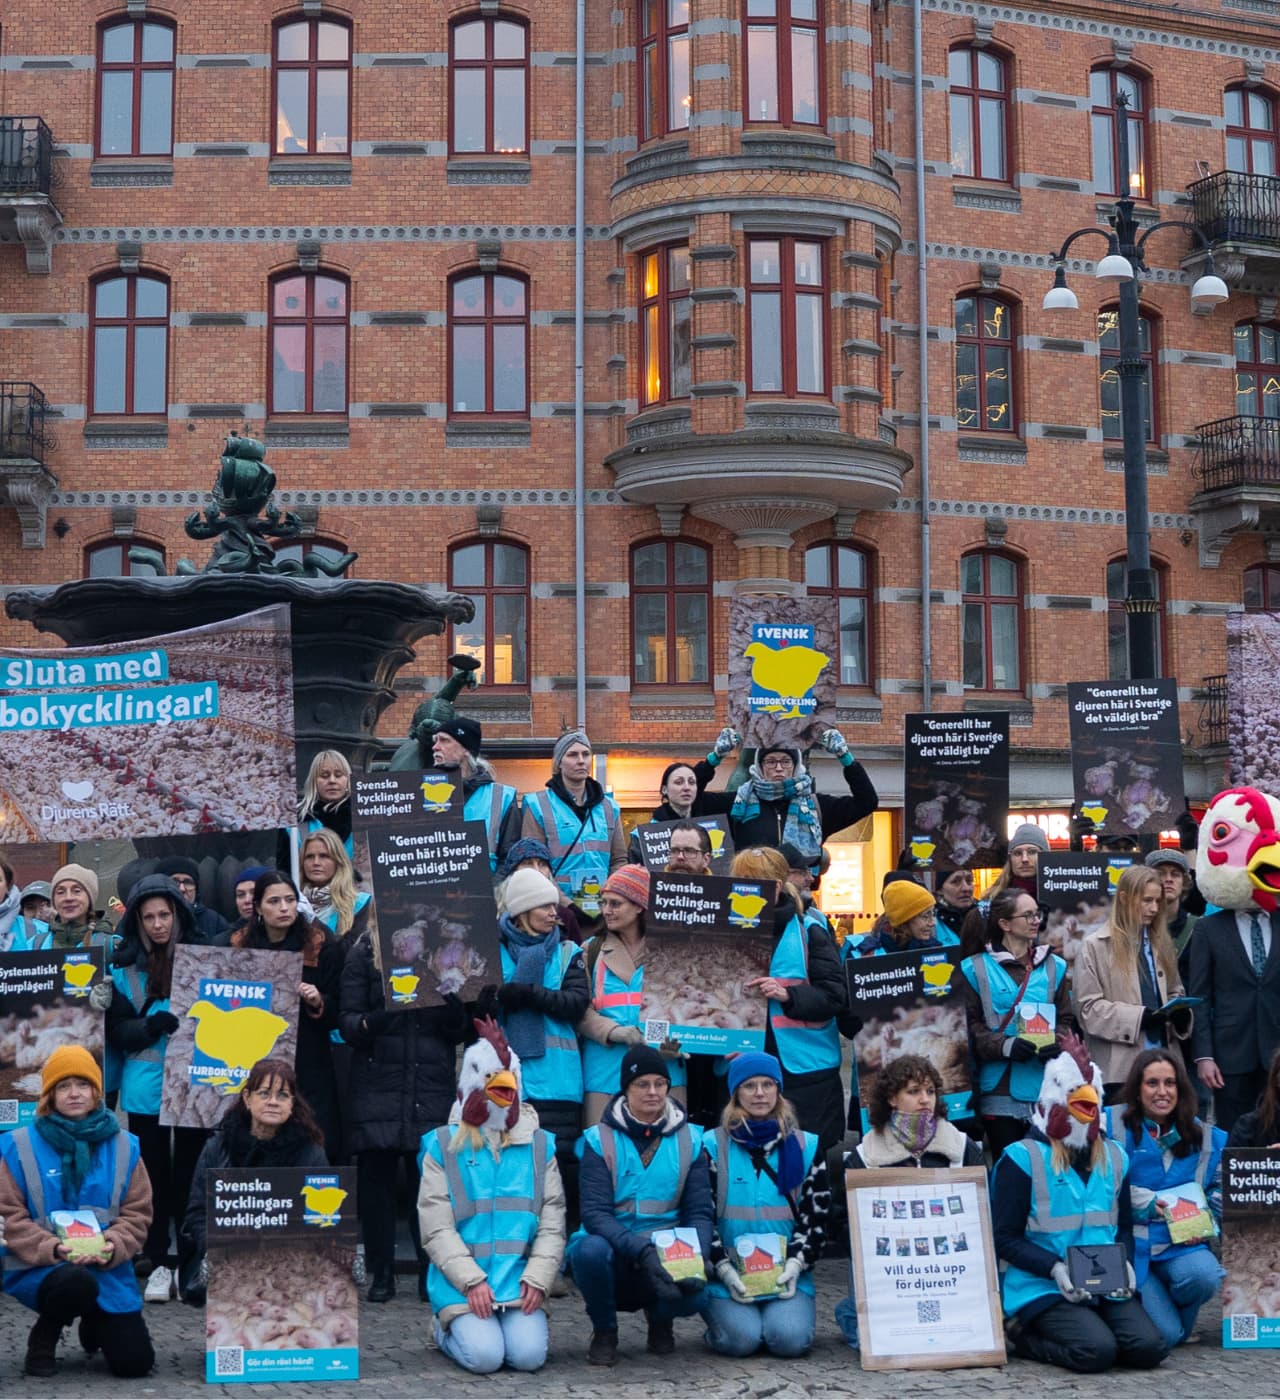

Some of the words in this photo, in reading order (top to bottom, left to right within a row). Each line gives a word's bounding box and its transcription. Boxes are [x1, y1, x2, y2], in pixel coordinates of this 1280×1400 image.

[758, 628, 808, 639] SVENSK
[6, 660, 85, 686] Sluta
[96, 652, 161, 681] med
[1140, 686, 1158, 695] har
[747, 697, 817, 706] TURBOKYCKLING
[1075, 701, 1109, 713] djuren
[1110, 700, 1128, 709] här
[1135, 699, 1171, 709] Sverige
[975, 719, 991, 728] har
[1085, 713, 1102, 723] det
[1104, 712, 1139, 723] väldigt
[911, 733, 943, 745] djuren
[945, 732, 962, 742] här
[968, 732, 1003, 743] Sverige
[920, 746, 936, 756] det
[938, 745, 971, 757] väldigt
[356, 779, 398, 790] Svenska
[357, 792, 415, 804] kycklingars
[42, 805, 96, 824] Djurens
[99, 802, 135, 817] Rätt.
[358, 804, 411, 816] verklighet!
[448, 831, 466, 841] har
[378, 852, 414, 865] djuren
[416, 848, 435, 859] här
[443, 845, 482, 858] Sverige
[389, 866, 408, 877] det
[410, 862, 448, 875] väldigt
[1044, 866, 1101, 877] Systematiskt
[657, 881, 703, 894] Svenska
[1044, 880, 1098, 891] djurplågeri!
[656, 895, 720, 911] kycklingars
[655, 911, 715, 924] verklighet!
[854, 967, 916, 985] Systematiskt
[204, 983, 266, 1000] SVENSK
[856, 982, 913, 1000] djurplågeri!
[1230, 1158, 1280, 1170] Svenska
[216, 1179, 271, 1192] Svenska
[216, 1196, 292, 1212] kycklingars
[216, 1213, 287, 1229] verklighet!
[884, 1265, 904, 1275] Vill
[906, 1264, 921, 1274] du
[924, 1264, 940, 1274] stå
[944, 1265, 966, 1275] upp
[896, 1279, 911, 1289] för
[914, 1277, 957, 1291] djuren?
